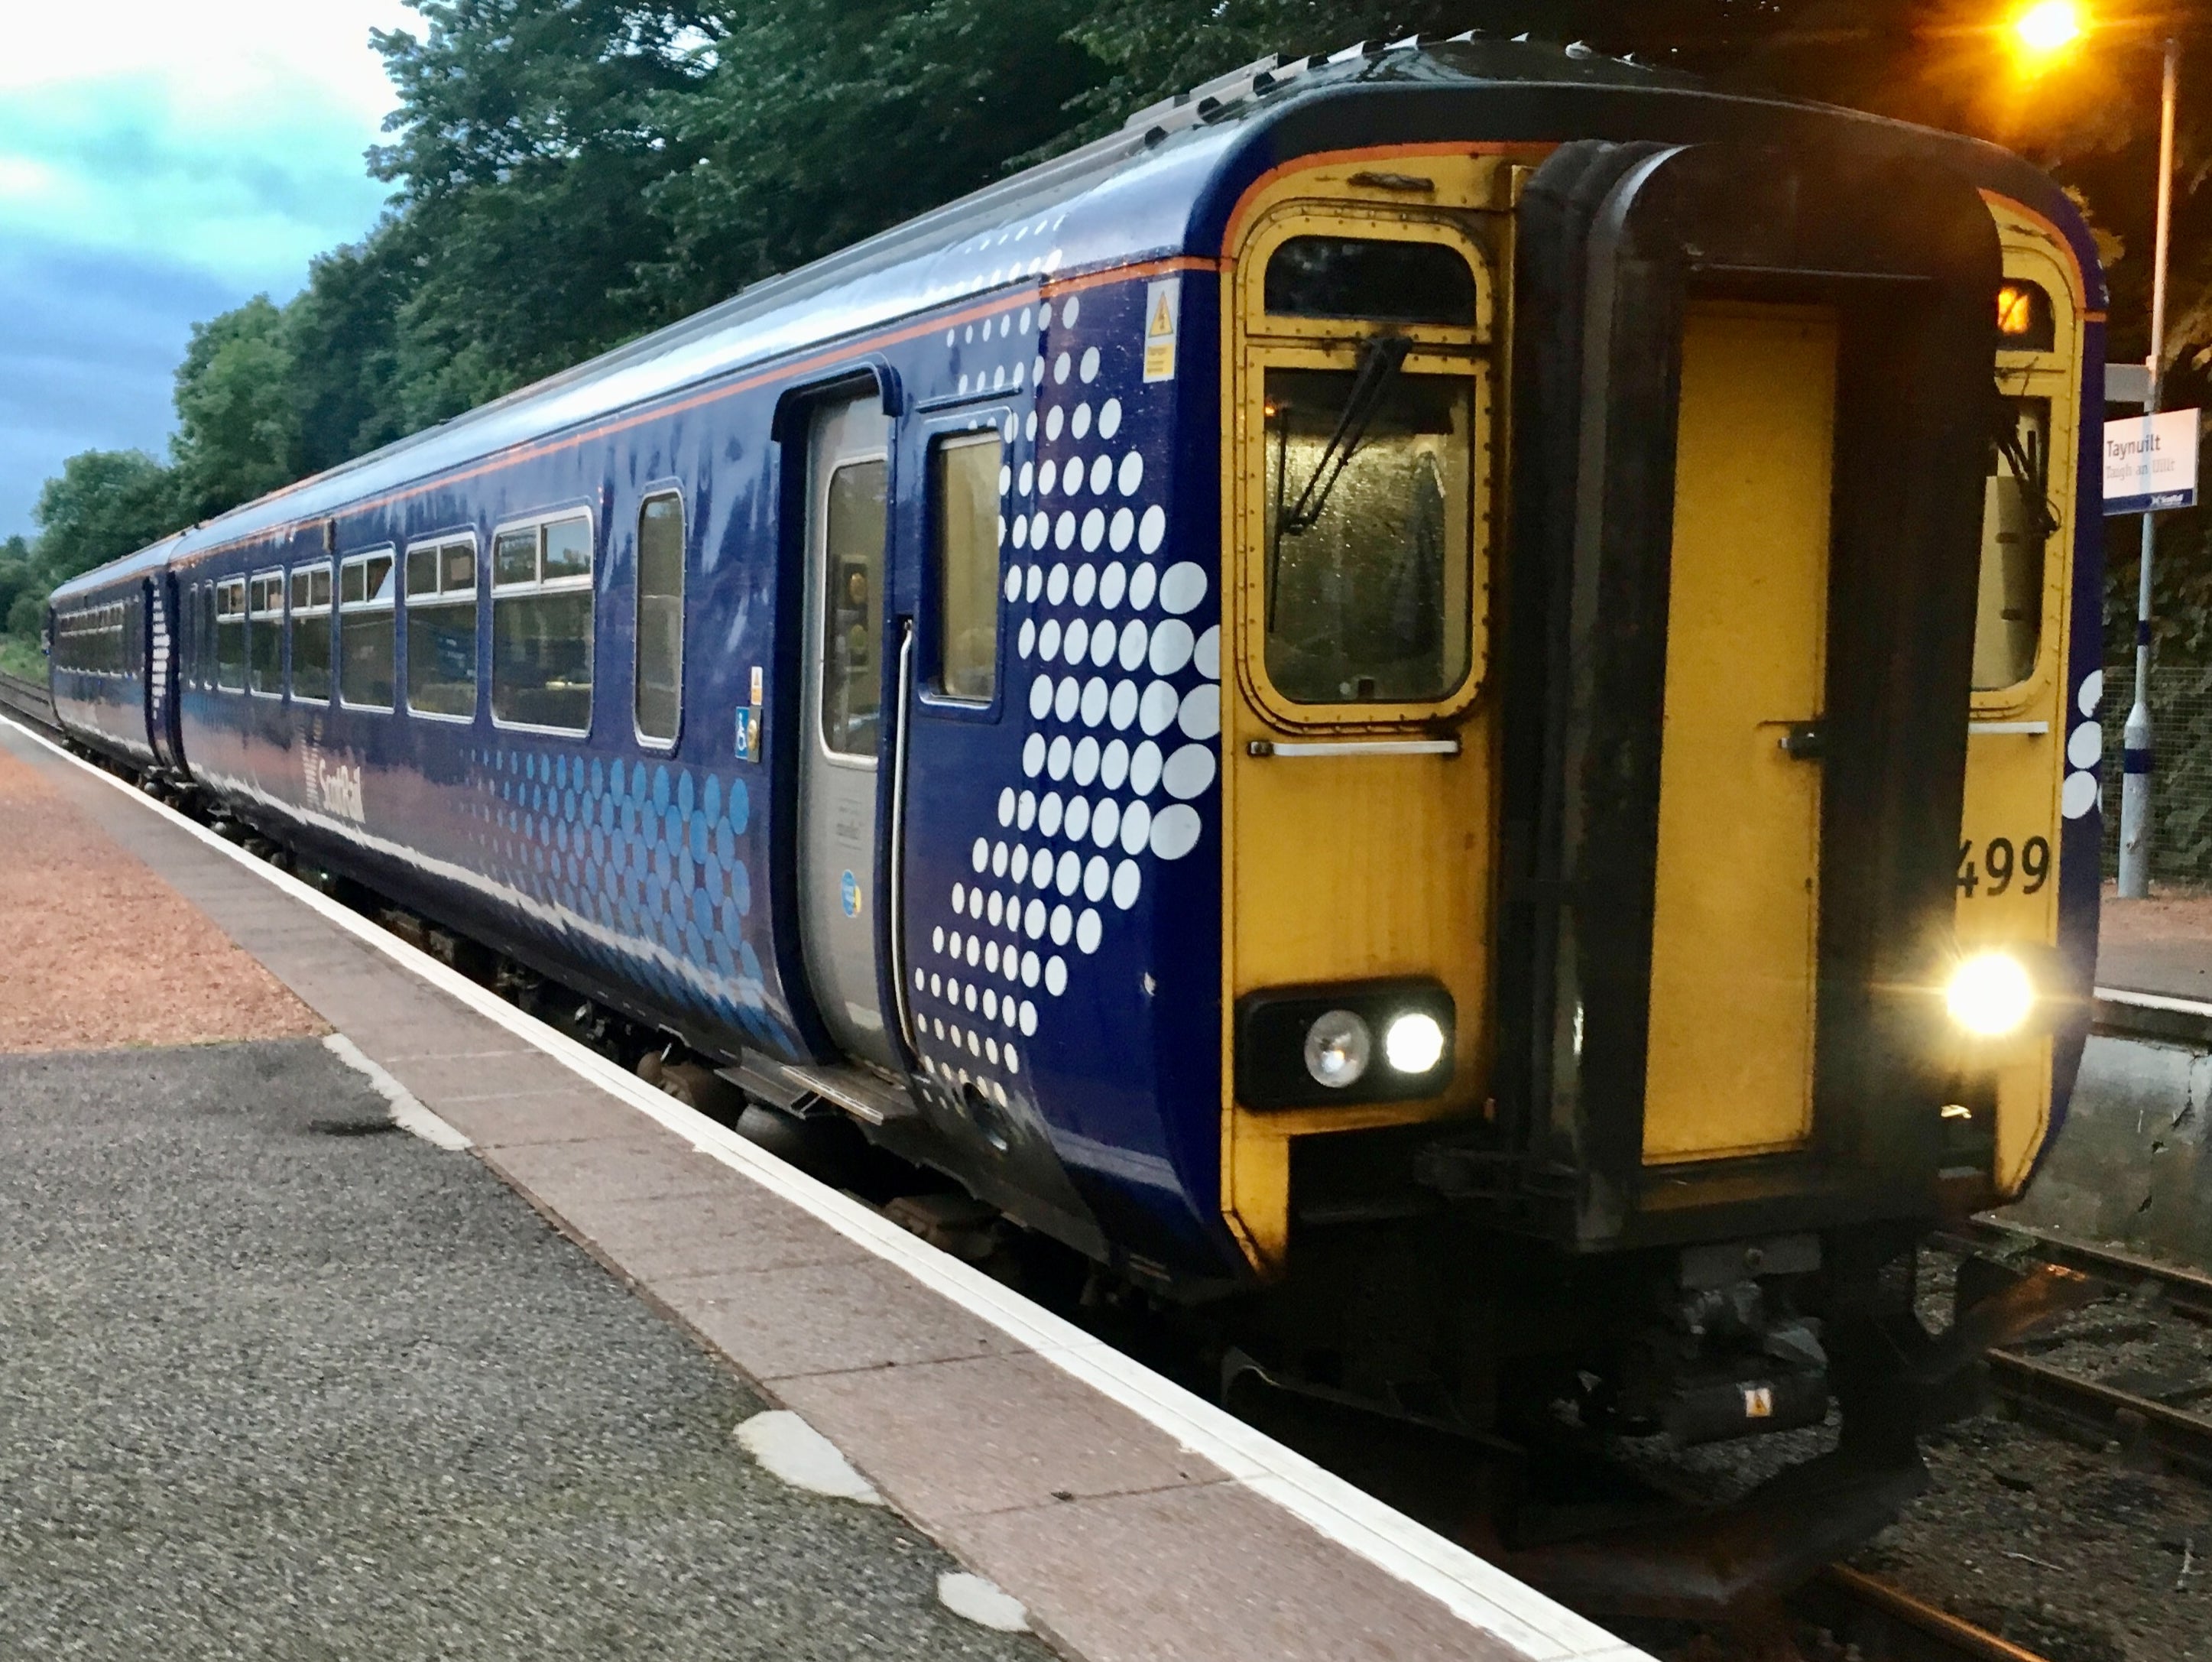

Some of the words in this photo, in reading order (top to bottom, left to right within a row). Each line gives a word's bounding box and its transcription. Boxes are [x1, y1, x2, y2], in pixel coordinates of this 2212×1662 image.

[2107, 433, 2162, 460] Taynuilt
[2136, 465, 2149, 476] an
[319, 758, 366, 823] ScotRail
[1957, 836, 2050, 898] 499
